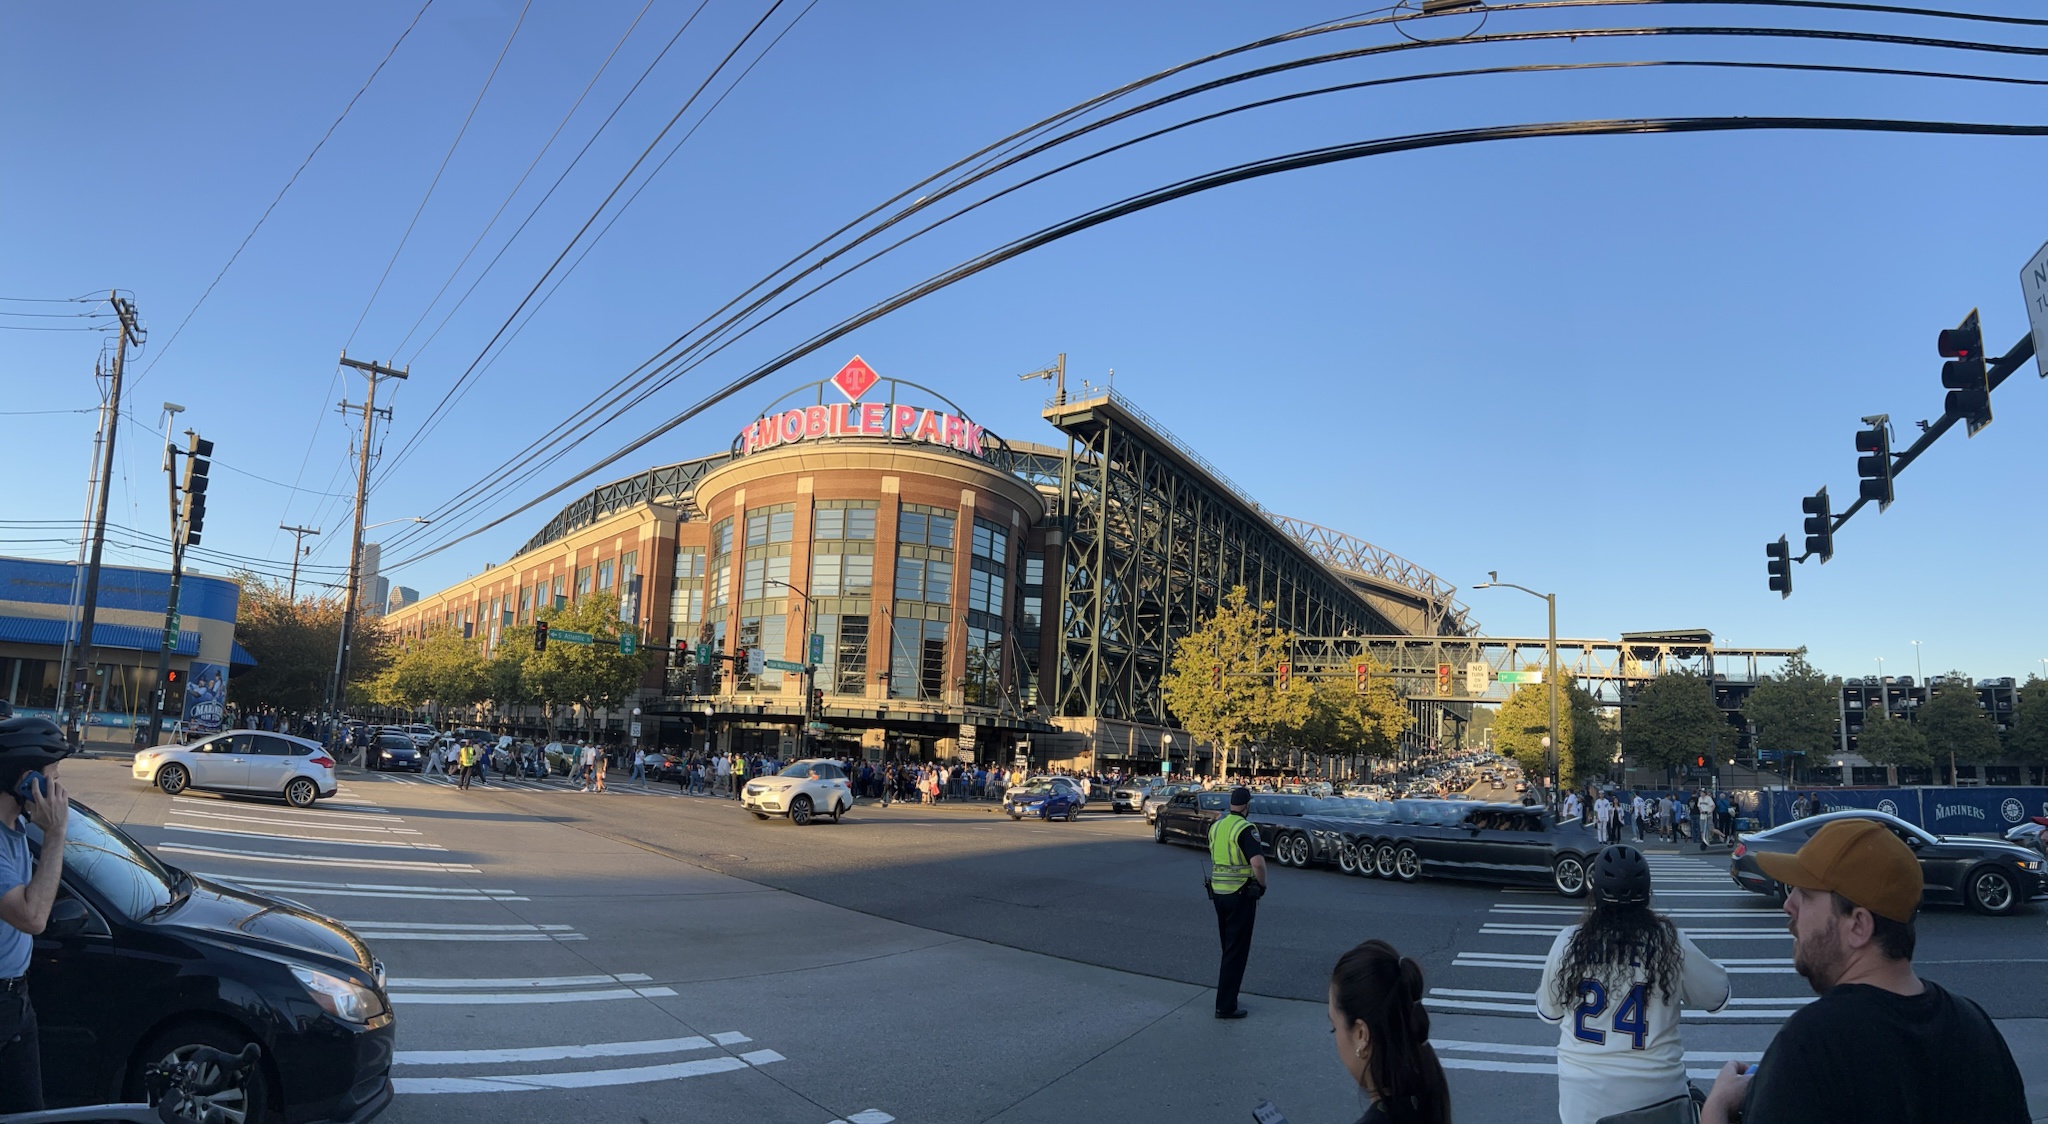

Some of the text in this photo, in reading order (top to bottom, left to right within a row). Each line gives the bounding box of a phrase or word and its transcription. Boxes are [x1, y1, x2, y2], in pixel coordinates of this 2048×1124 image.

[2034, 258, 2048, 290] N
[845, 367, 866, 391] T
[742, 403, 984, 458] T-MOBILE PARK
[564, 633, 585, 642] Atlantic
[1936, 804, 1985, 820] MARINERS
[1574, 977, 1649, 1050] 24
